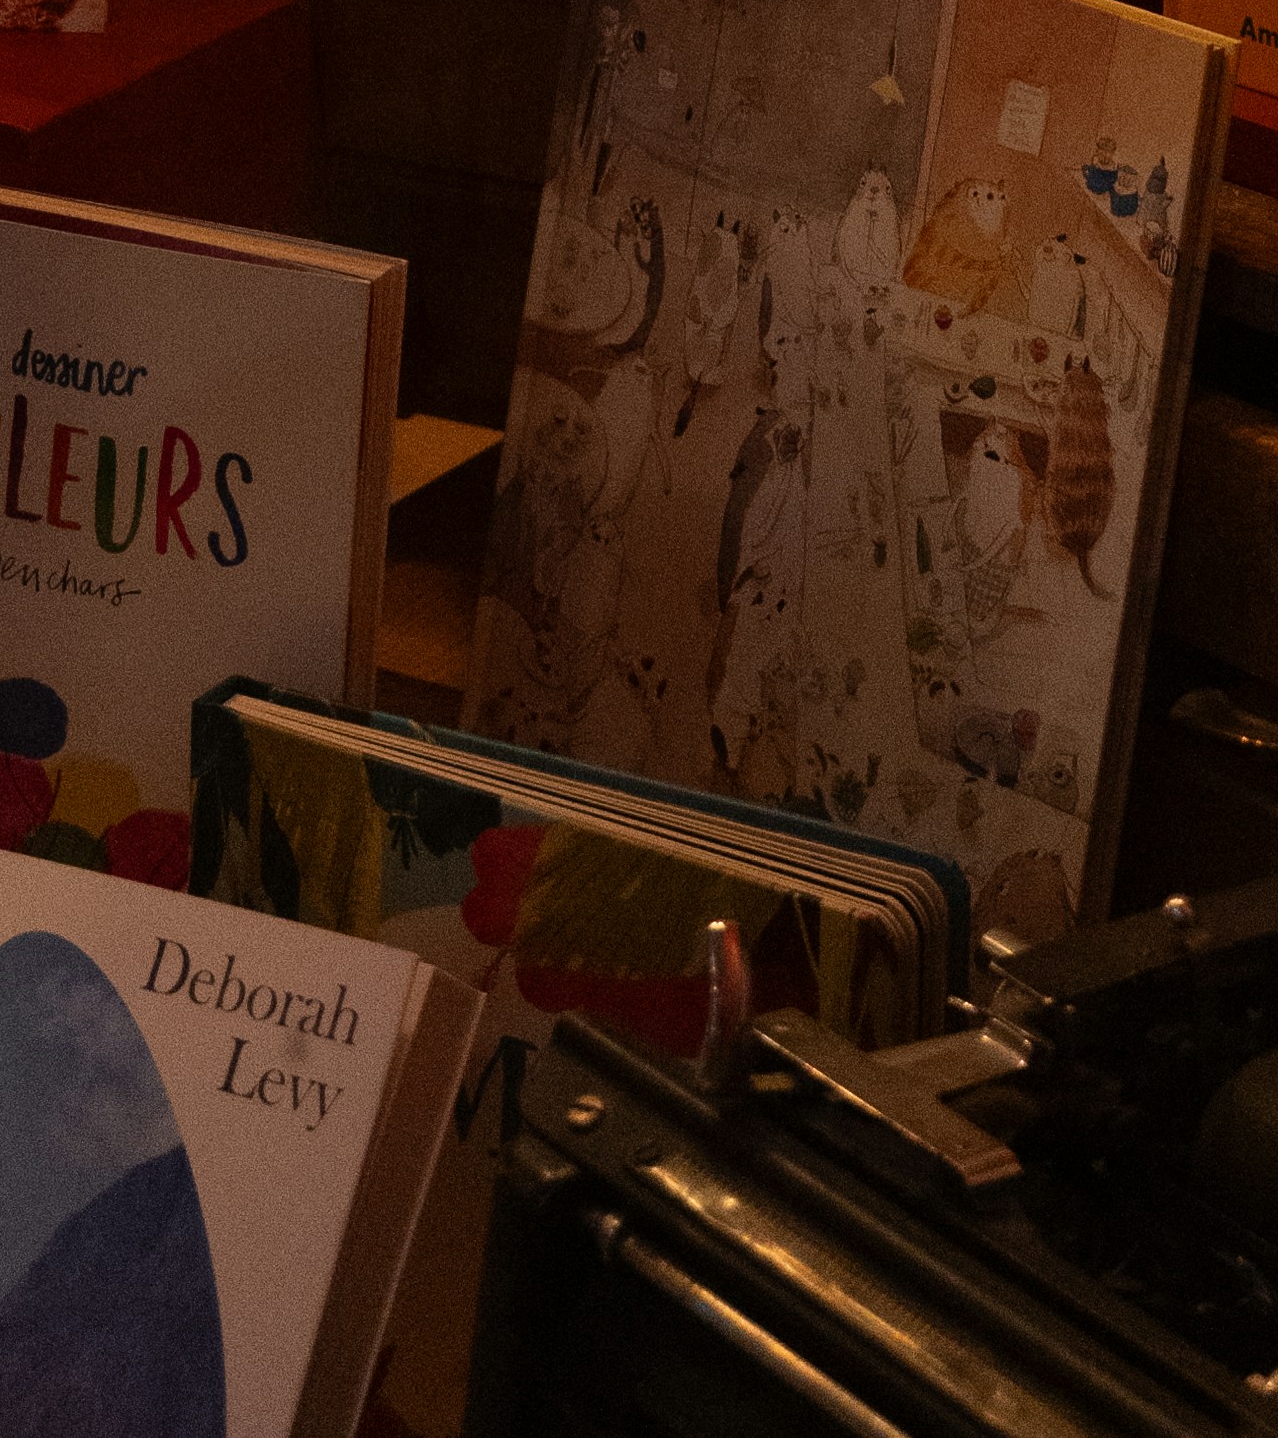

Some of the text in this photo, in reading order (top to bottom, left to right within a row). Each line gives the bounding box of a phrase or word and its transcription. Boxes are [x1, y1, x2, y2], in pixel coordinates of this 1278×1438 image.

[12, 329, 150, 396] dessiner
[142, 937, 360, 1046] Deborah
[217, 1036, 346, 1132] Levy
